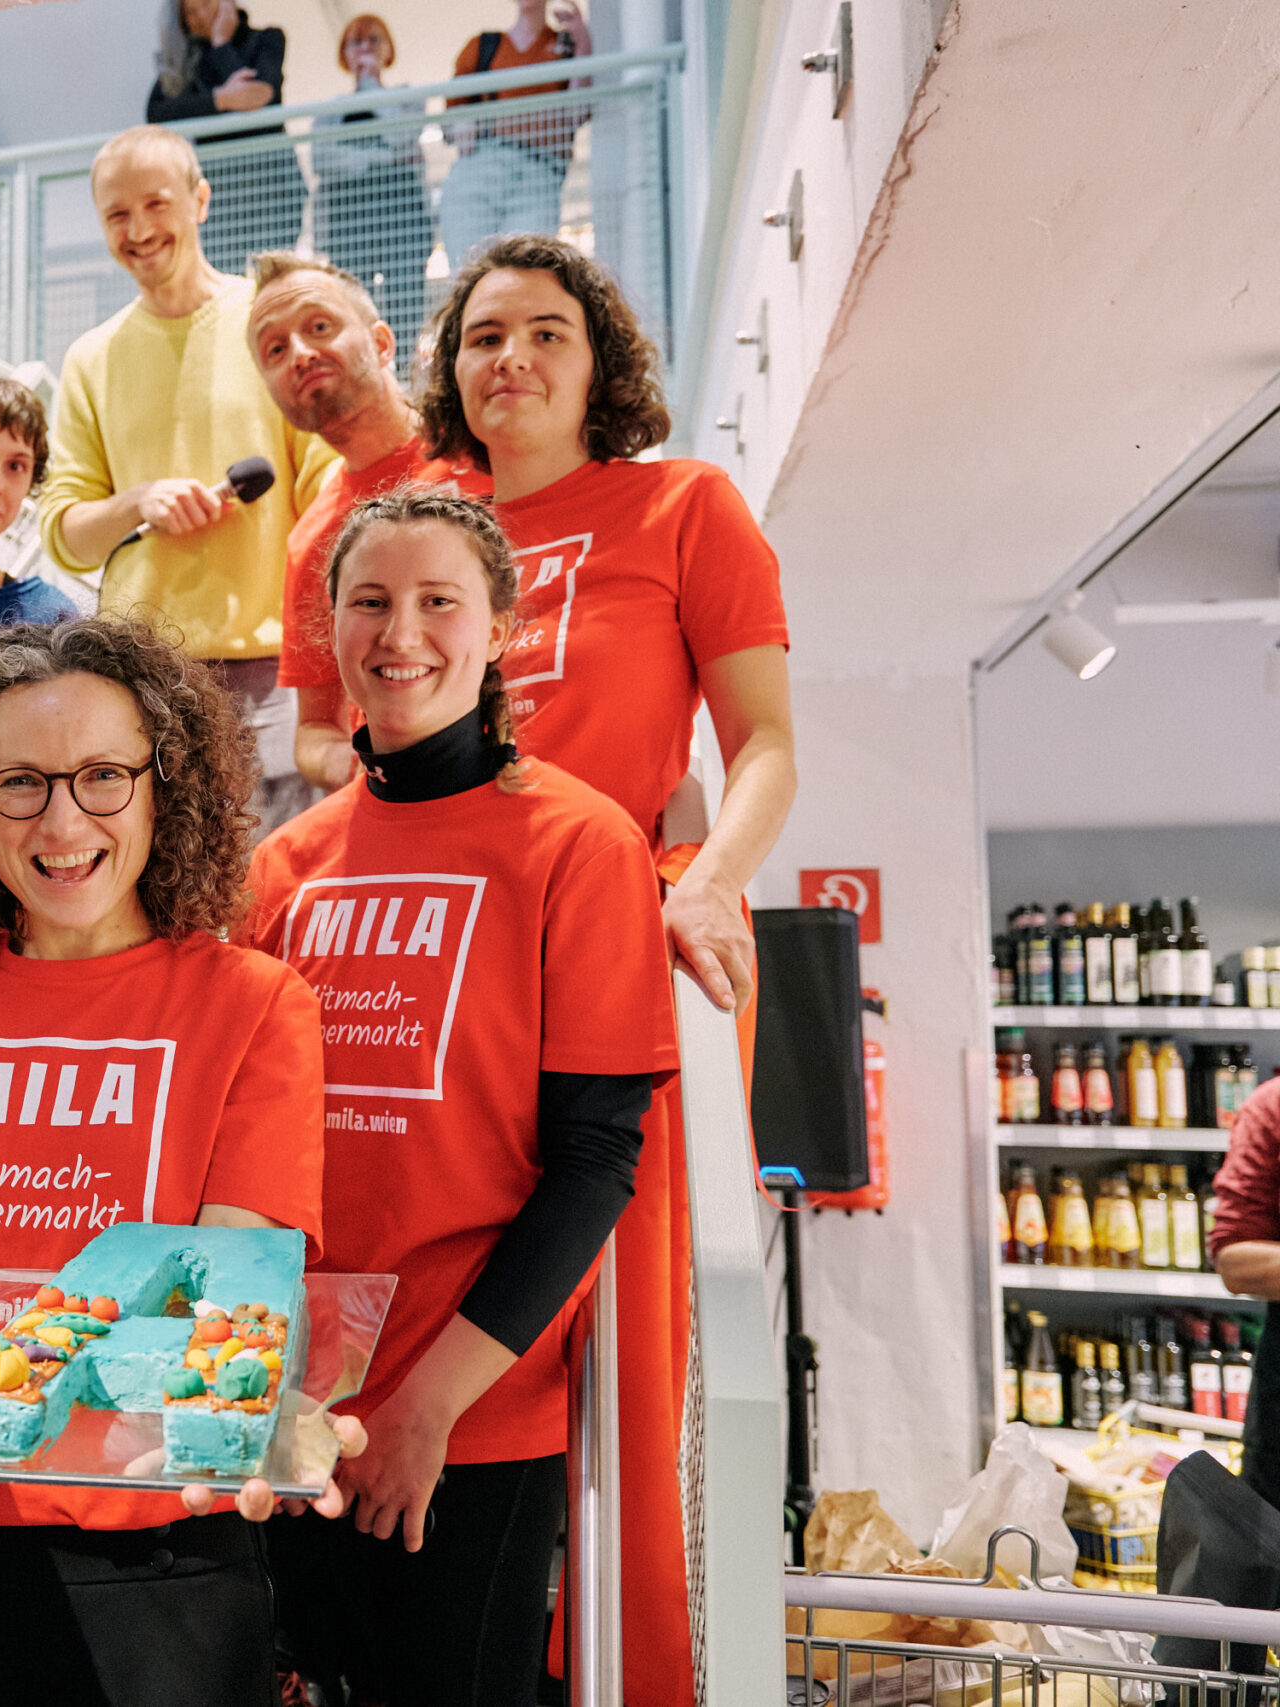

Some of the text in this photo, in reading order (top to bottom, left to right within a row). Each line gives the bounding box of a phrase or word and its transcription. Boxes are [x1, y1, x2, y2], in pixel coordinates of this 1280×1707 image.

[299, 896, 449, 957] MILA
[313, 980, 417, 1011] itmach-
[326, 1107, 408, 1134] mila.wien
